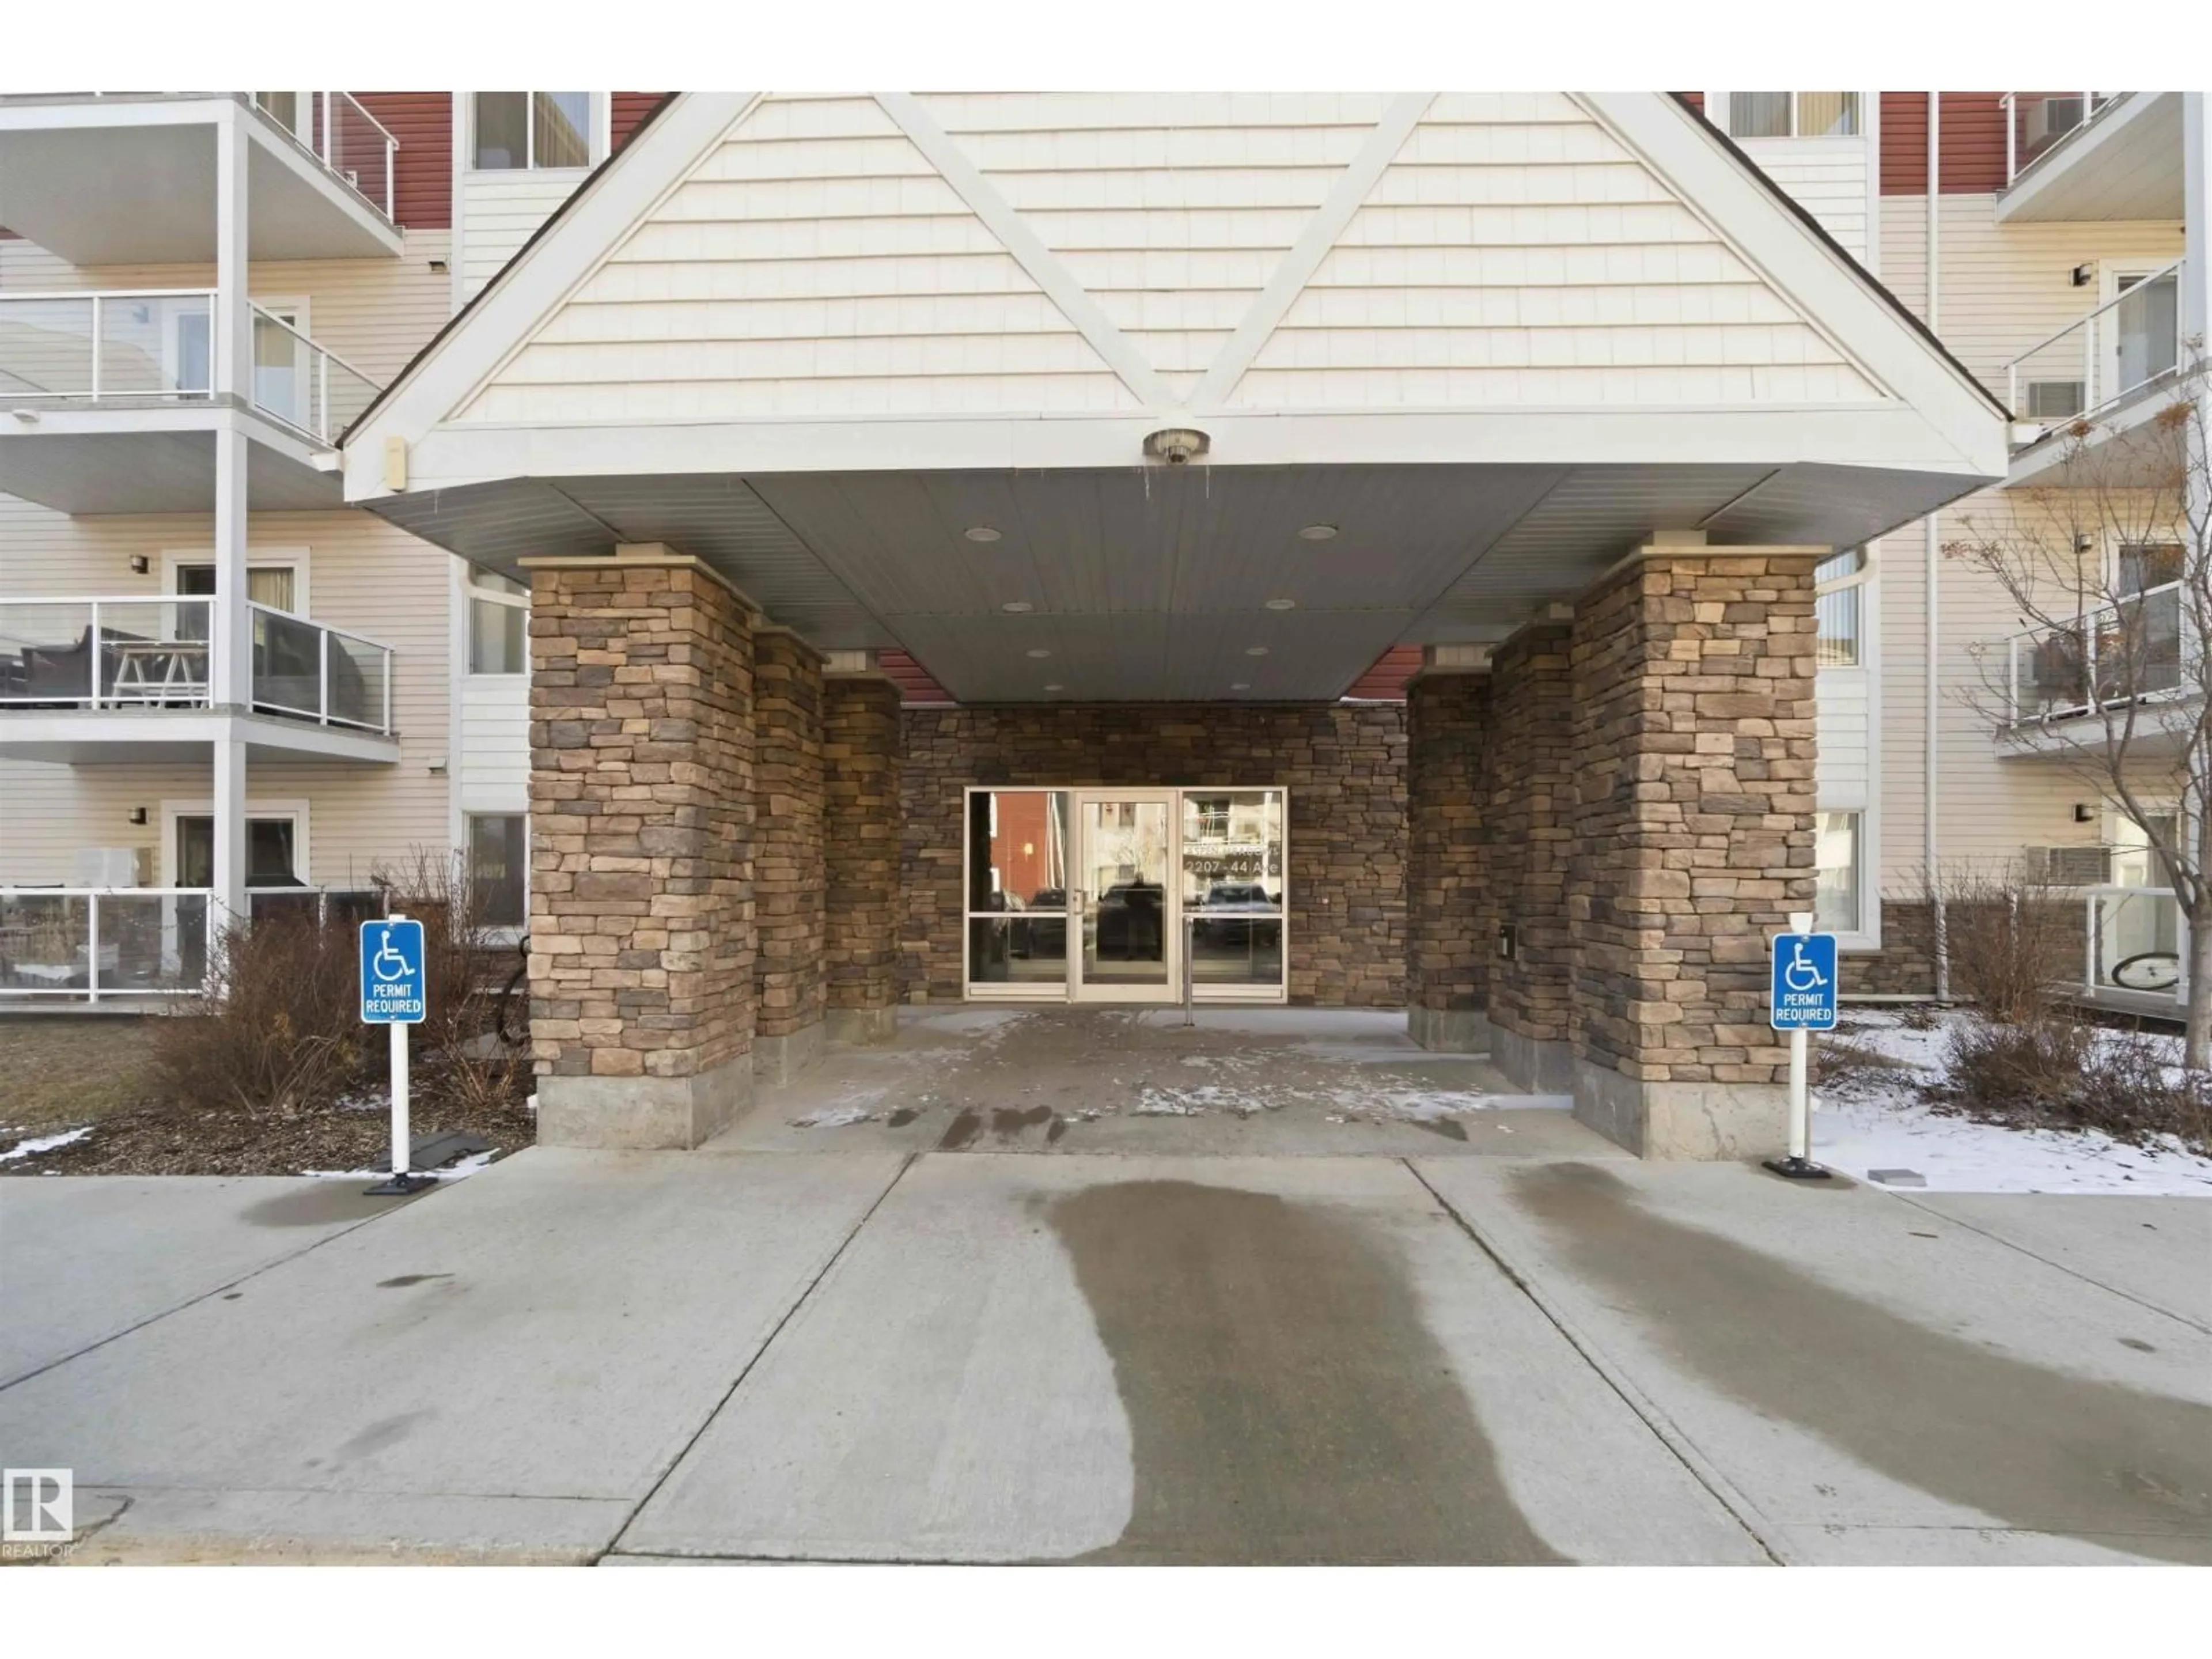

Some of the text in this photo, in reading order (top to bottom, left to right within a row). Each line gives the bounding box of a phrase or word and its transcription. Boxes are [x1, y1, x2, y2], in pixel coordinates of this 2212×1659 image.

[1185, 861, 1220, 872] 2207
[1230, 861, 1247, 872] 44
[373, 984, 412, 997] PERMIT
[366, 999, 421, 1013] REQUIRED
[1784, 994, 1824, 1006] PERMIT
[1776, 1009, 1831, 1021] REQUIRED
